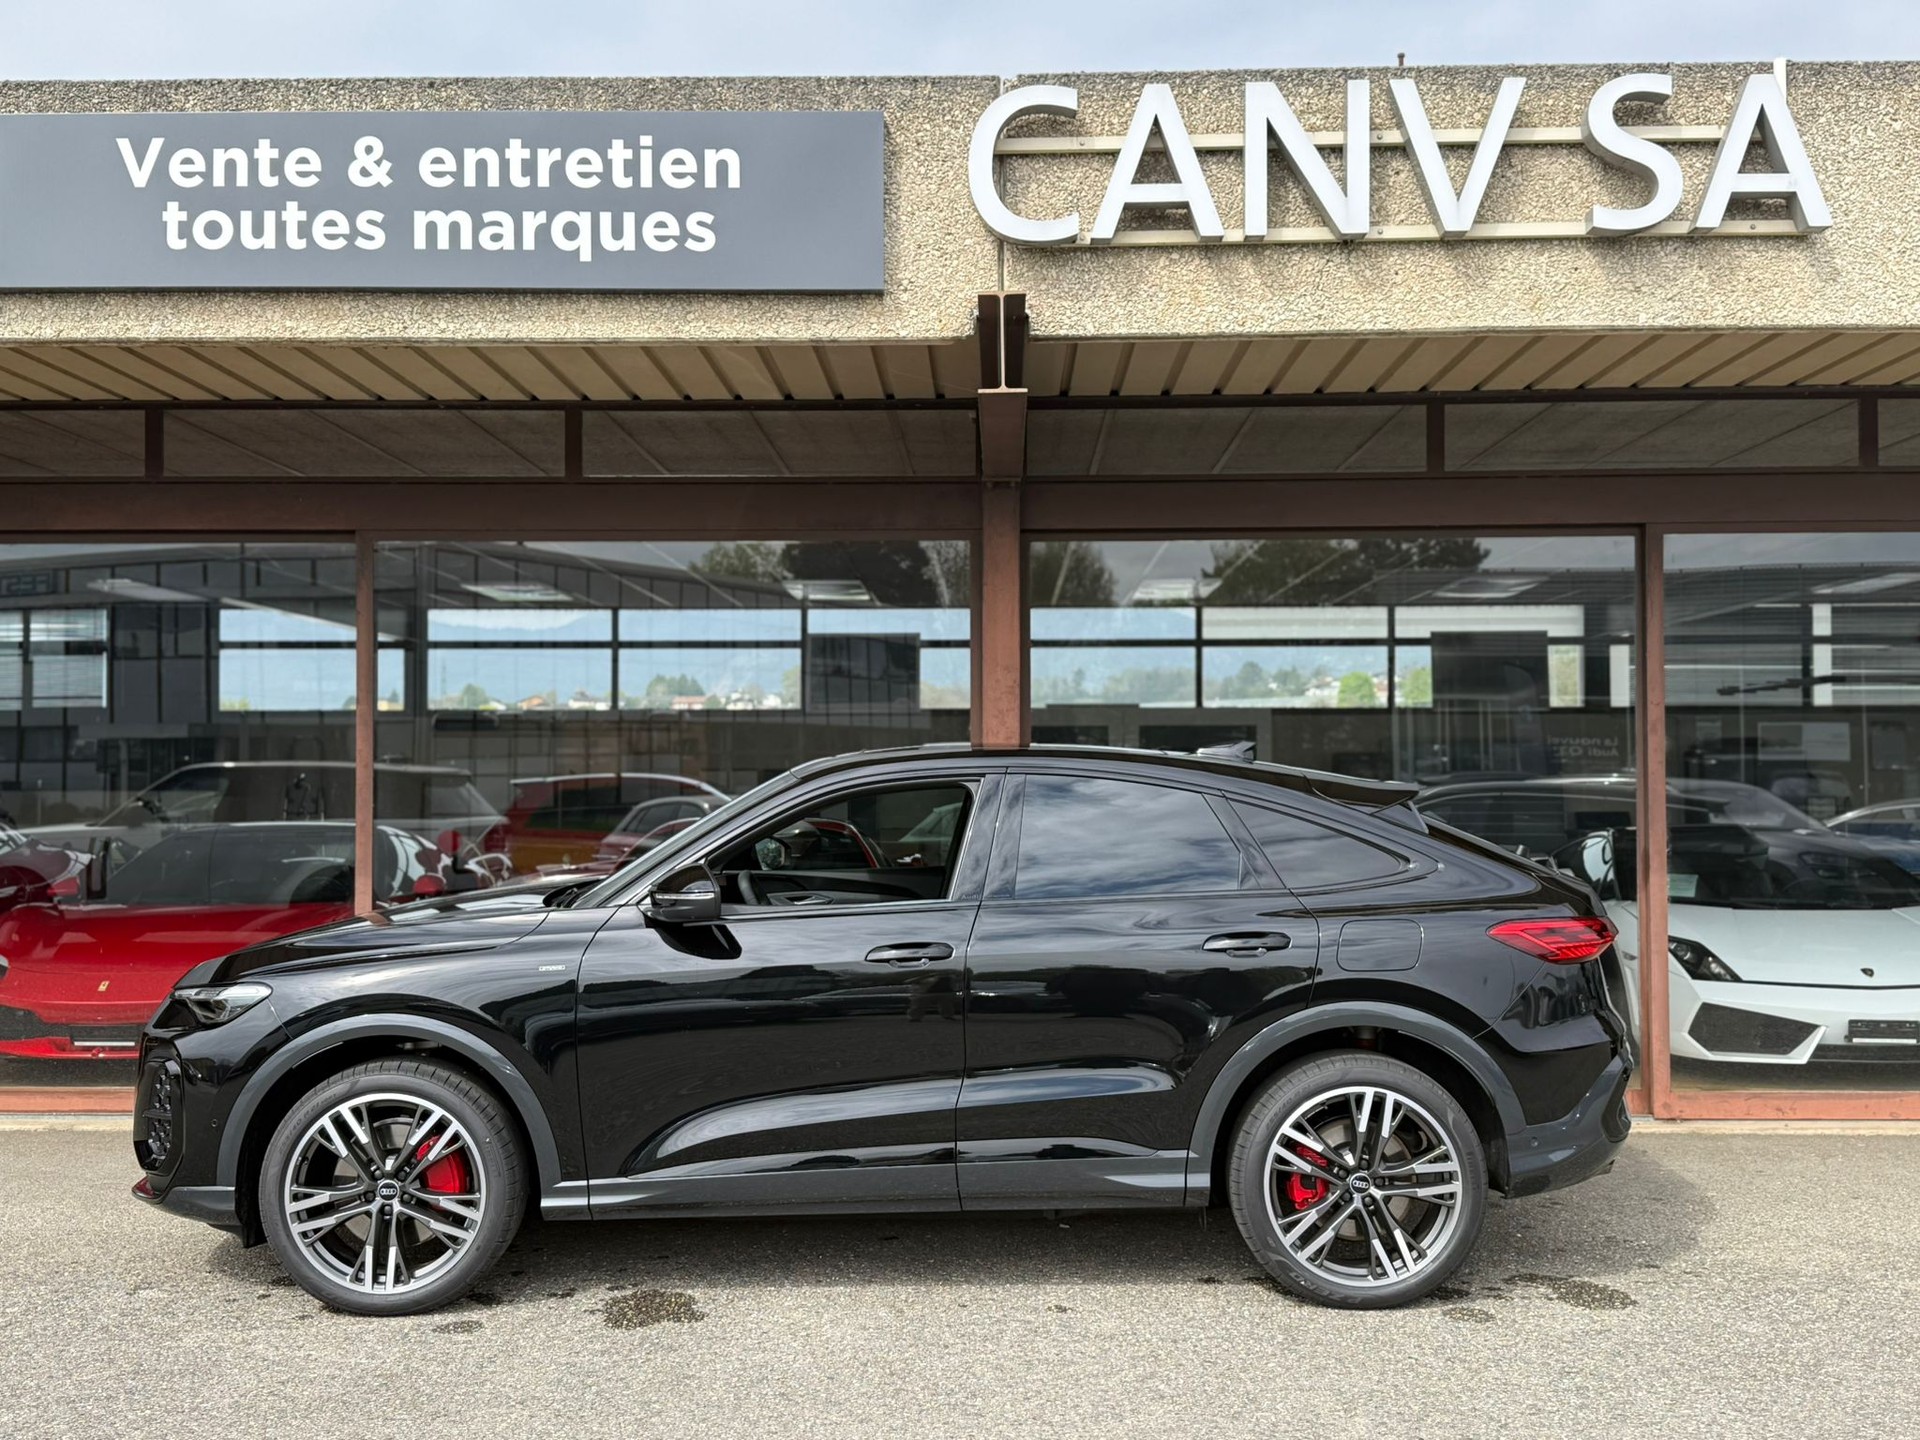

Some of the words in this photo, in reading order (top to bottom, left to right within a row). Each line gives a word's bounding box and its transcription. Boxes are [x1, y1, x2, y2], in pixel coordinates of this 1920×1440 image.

[116, 138, 321, 188] Vente
[348, 136, 393, 187] &
[419, 136, 741, 189] entretien
[968, 76, 1527, 246] CANV
[1583, 71, 1832, 234] SA
[162, 201, 386, 250] toutes
[414, 208, 716, 262] marques
